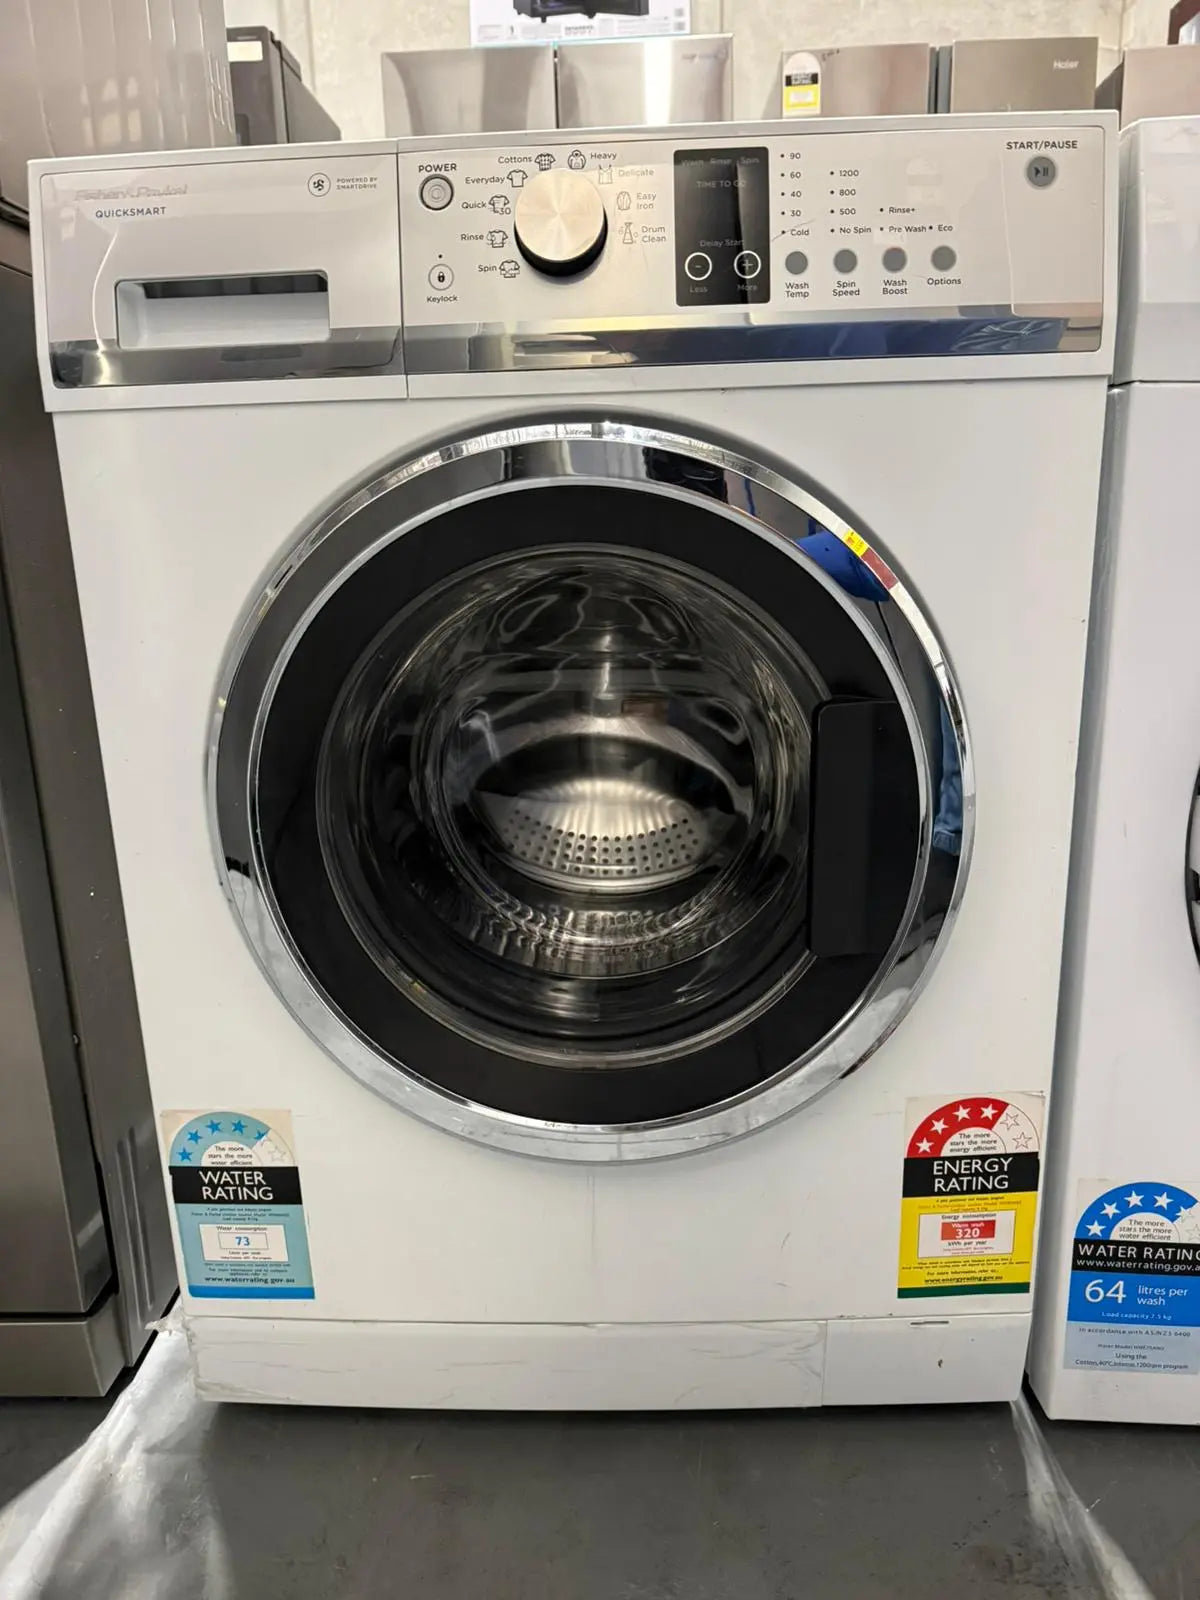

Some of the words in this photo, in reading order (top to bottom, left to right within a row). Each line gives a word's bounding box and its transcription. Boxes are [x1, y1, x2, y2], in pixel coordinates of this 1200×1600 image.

[1006, 140, 1078, 150] START/PAUSE
[498, 155, 533, 164] Cottons
[590, 151, 617, 160] Heavy
[789, 152, 801, 160] 90
[418, 163, 457, 173] POWER
[618, 168, 655, 177] Delicate
[789, 171, 802, 179] 60
[839, 169, 860, 177] 1200
[465, 176, 505, 185] Everyday
[696, 180, 717, 189] TIME
[720, 180, 732, 188] TO
[636, 192, 657, 201] Easy
[790, 190, 802, 198] 40
[839, 189, 857, 197] 800
[461, 201, 487, 209] Quick
[636, 202, 654, 210] Iron
[95, 206, 166, 218] QUICKSMART
[790, 209, 802, 217] 30
[840, 208, 857, 216] 500
[889, 206, 916, 214] Rinse+
[641, 225, 666, 233] Drum
[790, 228, 810, 236] Cold
[853, 226, 872, 236] Spin
[905, 225, 927, 233] Wash
[460, 233, 485, 241] Rinse
[641, 235, 667, 243] Clean
[700, 239, 723, 248] Delay
[725, 239, 745, 247] Start
[477, 264, 497, 273] Spin
[785, 282, 810, 290] Wash
[836, 280, 856, 289] Spin
[883, 279, 908, 287] Wash
[927, 277, 962, 287] Options
[689, 286, 708, 294] Less
[737, 284, 758, 292] More
[882, 287, 908, 295] Boost
[785, 291, 810, 299] Temp
[832, 289, 860, 297] Speed
[426, 295, 458, 304] Keylock
[933, 1157, 1013, 1176] ENERGY
[199, 1170, 267, 1185] WATER
[934, 1174, 1009, 1193] RATING
[202, 1186, 274, 1201] RATING
[1128, 1219, 1144, 1227] The
[955, 1228, 980, 1239] 320
[1142, 1233, 1172, 1241] efficient
[235, 1236, 250, 1247] 73
[1078, 1243, 1137, 1258] WATER
[1085, 1279, 1127, 1304] 64
[1138, 1285, 1166, 1296] litres
[1168, 1287, 1188, 1298] per
[1137, 1296, 1166, 1306] wash
[1120, 1312, 1149, 1320] capacity
[1115, 1352, 1136, 1361] Using
